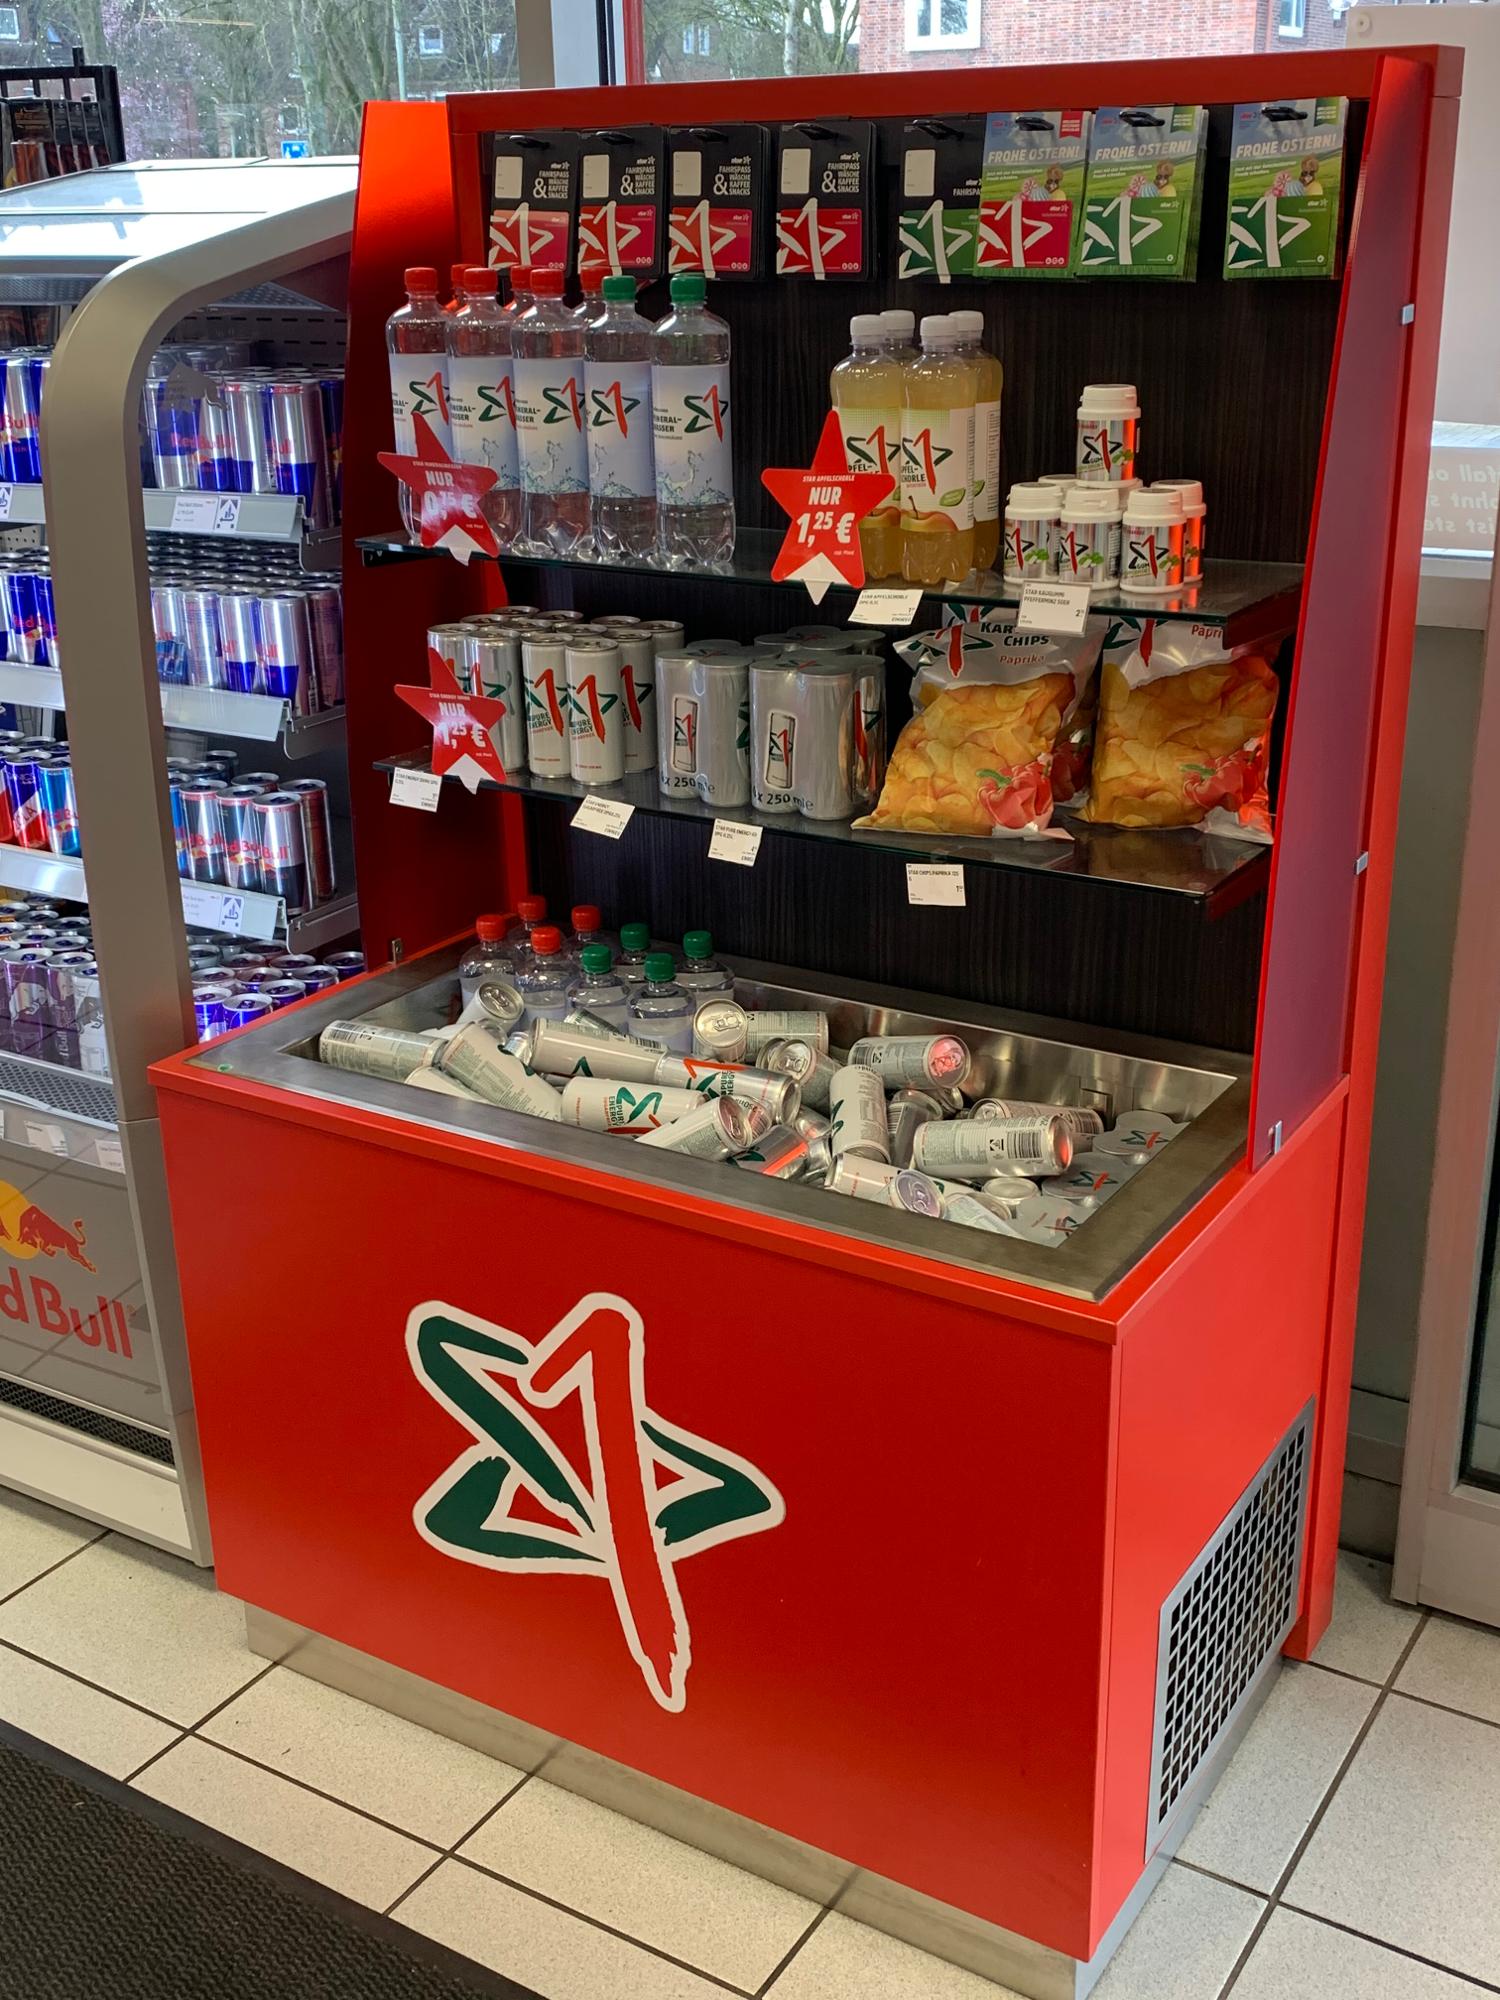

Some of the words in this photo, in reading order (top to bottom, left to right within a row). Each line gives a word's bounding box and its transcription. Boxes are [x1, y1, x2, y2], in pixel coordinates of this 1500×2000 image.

[988, 150, 1026, 163] FROHE
[1029, 146, 1080, 160] OSTERN!
[1095, 145, 1136, 160] FROHE
[1138, 140, 1192, 156] OSTERN!
[1236, 142, 1279, 158] FROHE
[1281, 134, 1337, 153] OSTERN!
[539, 170, 569, 178] FAHRSPASS
[719, 165, 751, 174] FAHRSPASS
[828, 162, 860, 170] FAHRSPASS
[533, 178, 548, 198] &
[620, 175, 635, 196] &
[713, 173, 728, 195] &
[821, 170, 837, 193] &
[837, 185, 859, 193] SNACKS
[425, 470, 454, 486] NUR
[816, 474, 855, 482] APFELSCHORLE
[808, 487, 842, 505] NUR
[461, 493, 477, 518] €
[835, 512, 855, 544] €
[981, 622, 1017, 634] KAR
[1192, 624, 1223, 639] Papri
[1004, 635, 1050, 647] CHIPS
[1000, 654, 1045, 666] Paprika
[439, 702, 466, 717] NUR
[471, 723, 486, 747] €
[674, 776, 696, 788] 250
[766, 793, 791, 805] 250
[728, 1070, 736, 1096] NERGY
[609, 1096, 619, 1126] ENERGY
[29, 1275, 133, 1360] Bull
